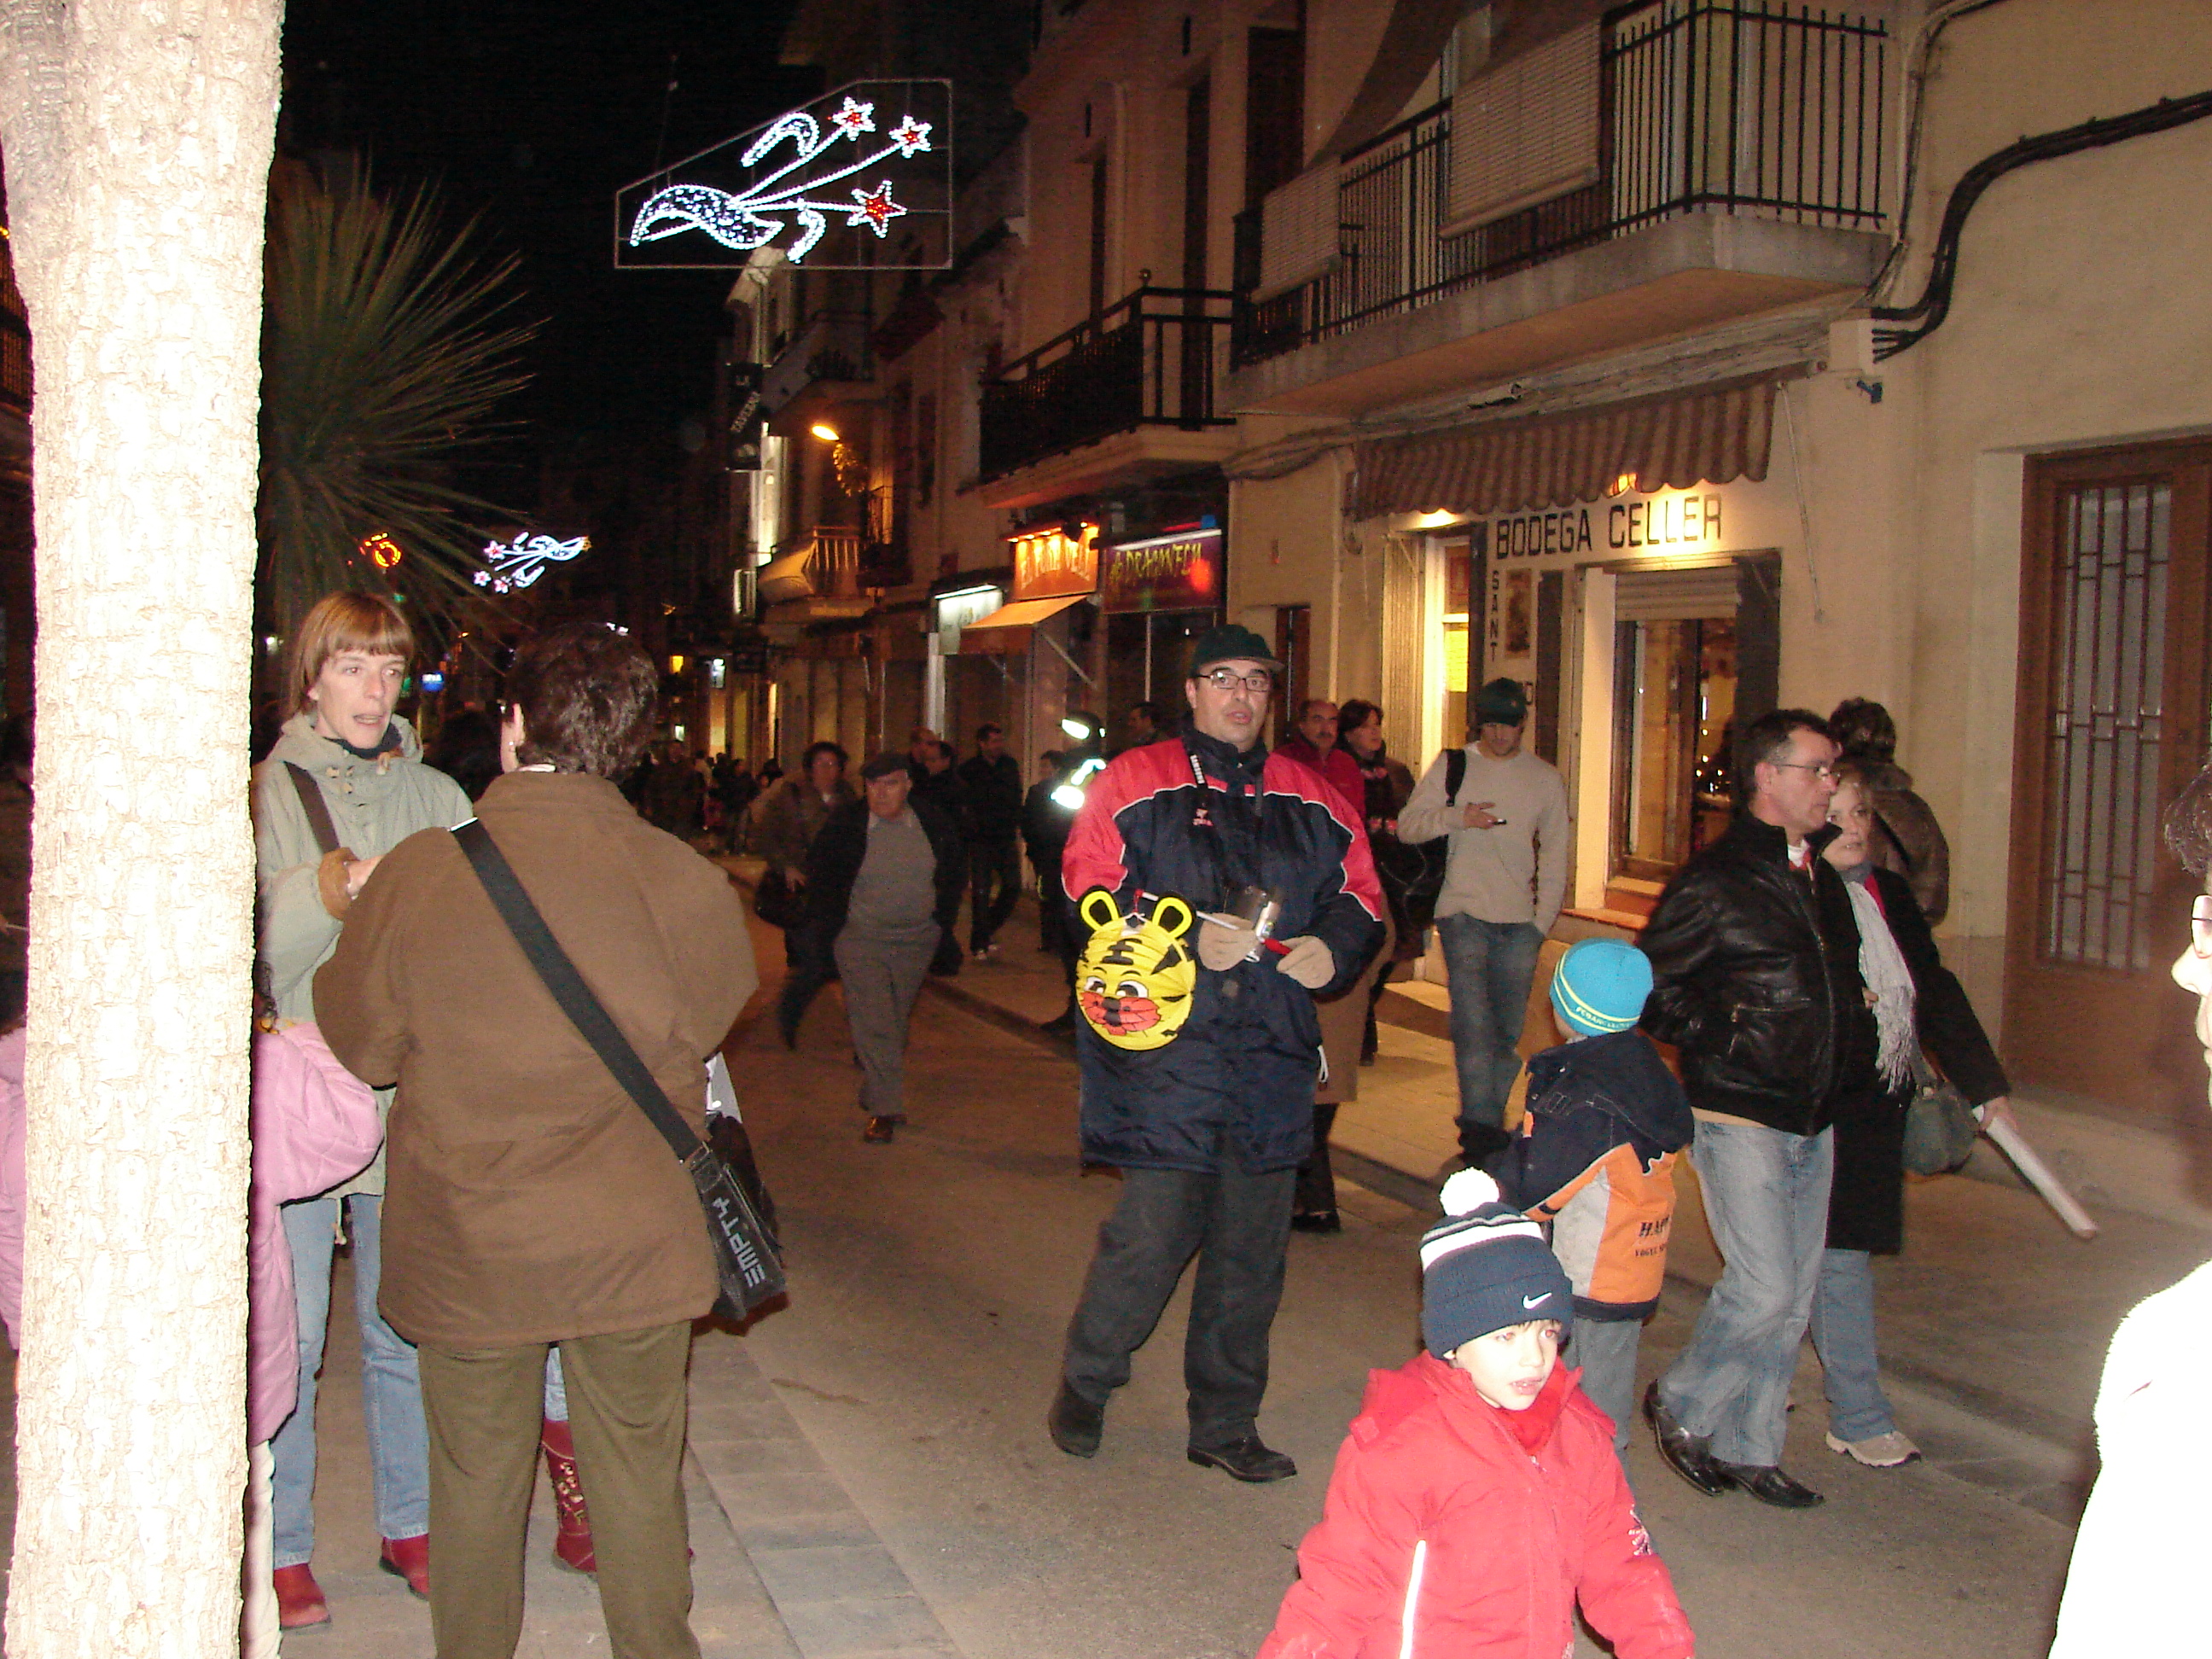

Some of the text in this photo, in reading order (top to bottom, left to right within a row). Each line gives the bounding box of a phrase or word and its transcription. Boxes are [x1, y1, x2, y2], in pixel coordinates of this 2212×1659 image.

[1497, 493, 1721, 559] BODEGA CELLER
[712, 1196, 766, 1289] EMPTY
